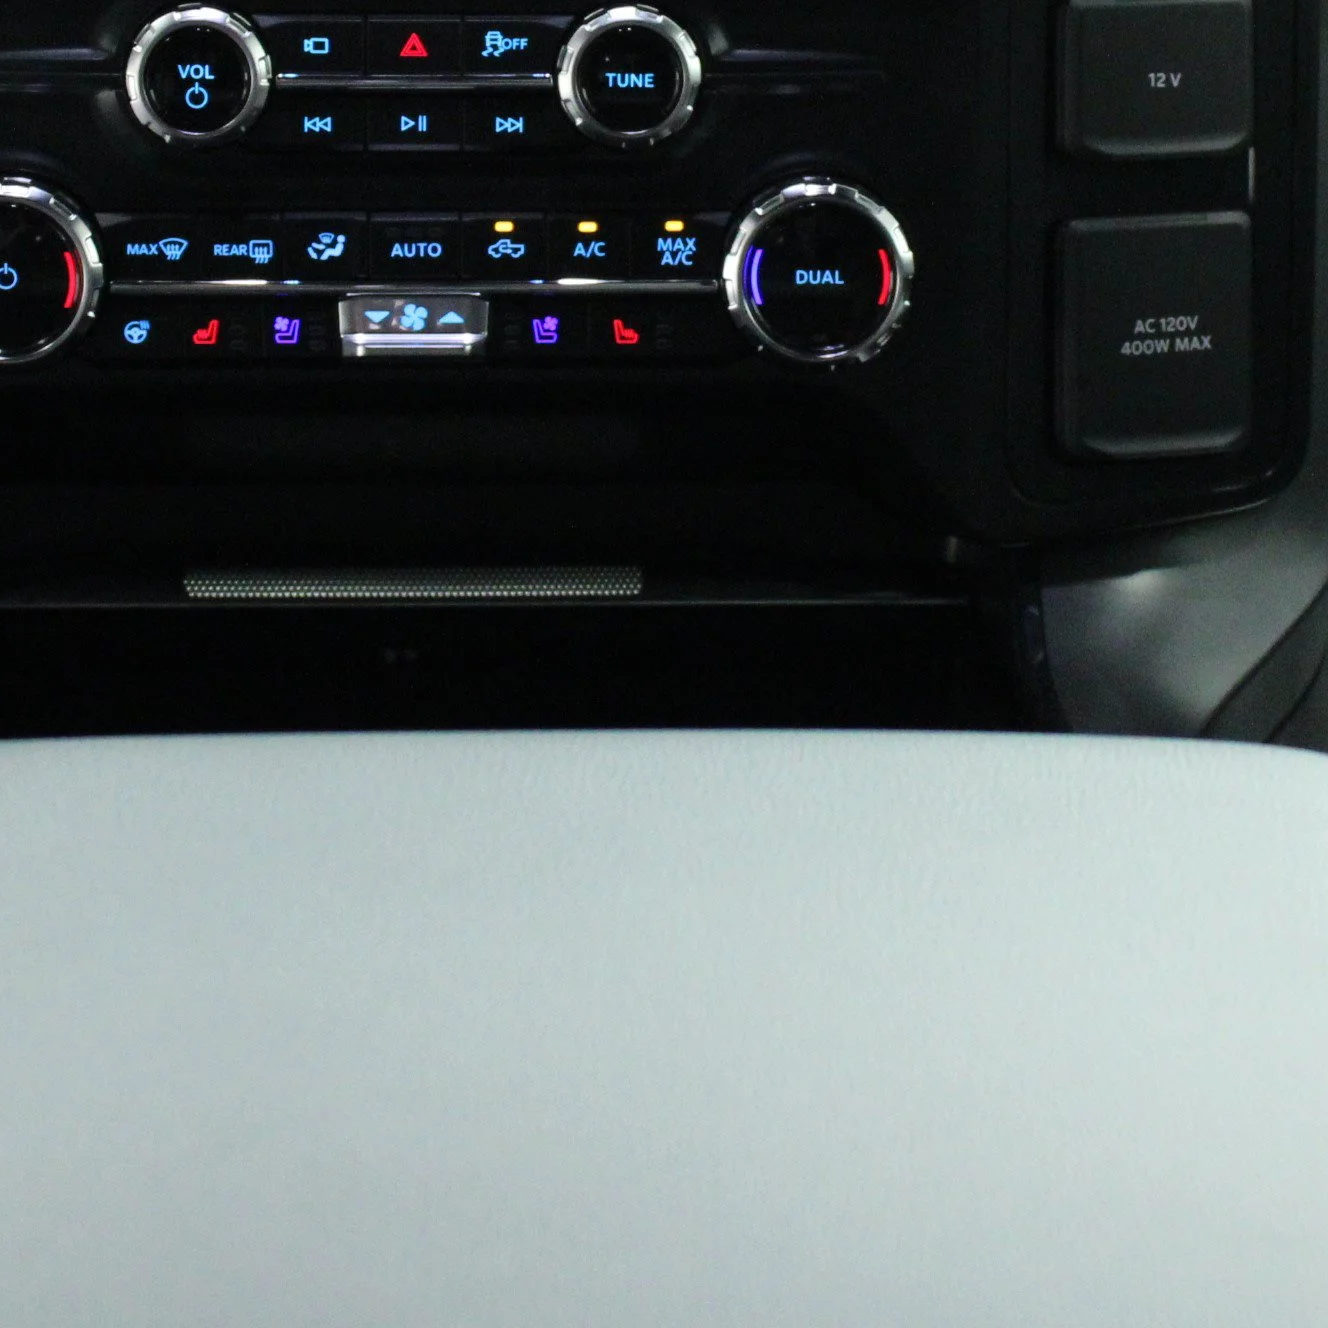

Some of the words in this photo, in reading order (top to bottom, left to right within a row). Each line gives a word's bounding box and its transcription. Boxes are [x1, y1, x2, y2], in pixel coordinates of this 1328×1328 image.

[502, 37, 529, 51] OFF
[177, 63, 215, 80] VOL
[605, 72, 655, 89] TUNE
[1147, 73, 1167, 88] 12
[1168, 73, 1183, 89] V
[126, 243, 159, 256] MAX
[213, 243, 249, 257] REAR
[390, 242, 443, 258] AUTO
[573, 240, 606, 258] A/C
[656, 237, 697, 252] MAX
[660, 250, 694, 267] A/C
[795, 269, 845, 286] DUAL
[1134, 319, 1157, 334] AC
[1158, 316, 1198, 332] 120V
[1120, 338, 1172, 356] 400W
[1175, 335, 1212, 352] MAX
